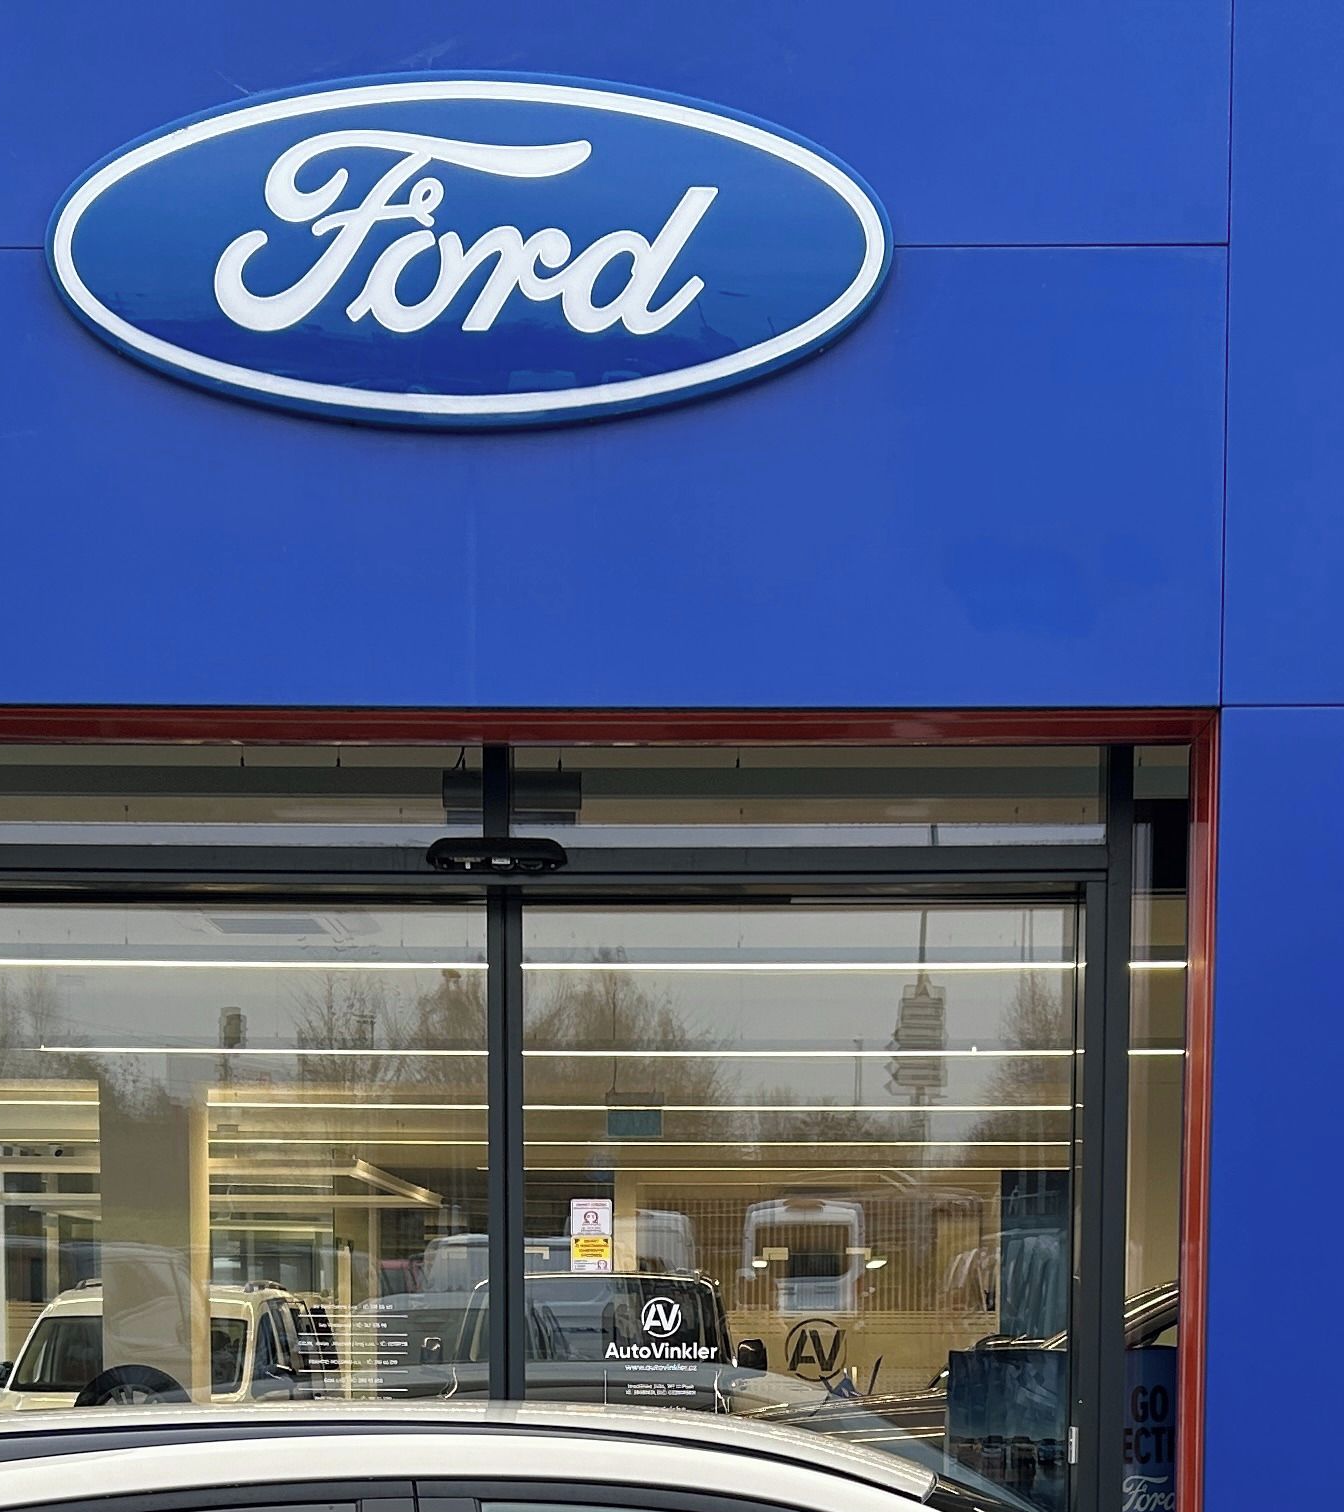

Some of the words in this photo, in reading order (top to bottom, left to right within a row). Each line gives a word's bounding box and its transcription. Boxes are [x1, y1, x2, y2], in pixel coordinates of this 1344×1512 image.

[214, 129, 719, 335] Ford
[604, 1342, 718, 1361] AutoVinkler
[1130, 1384, 1170, 1423] GO
